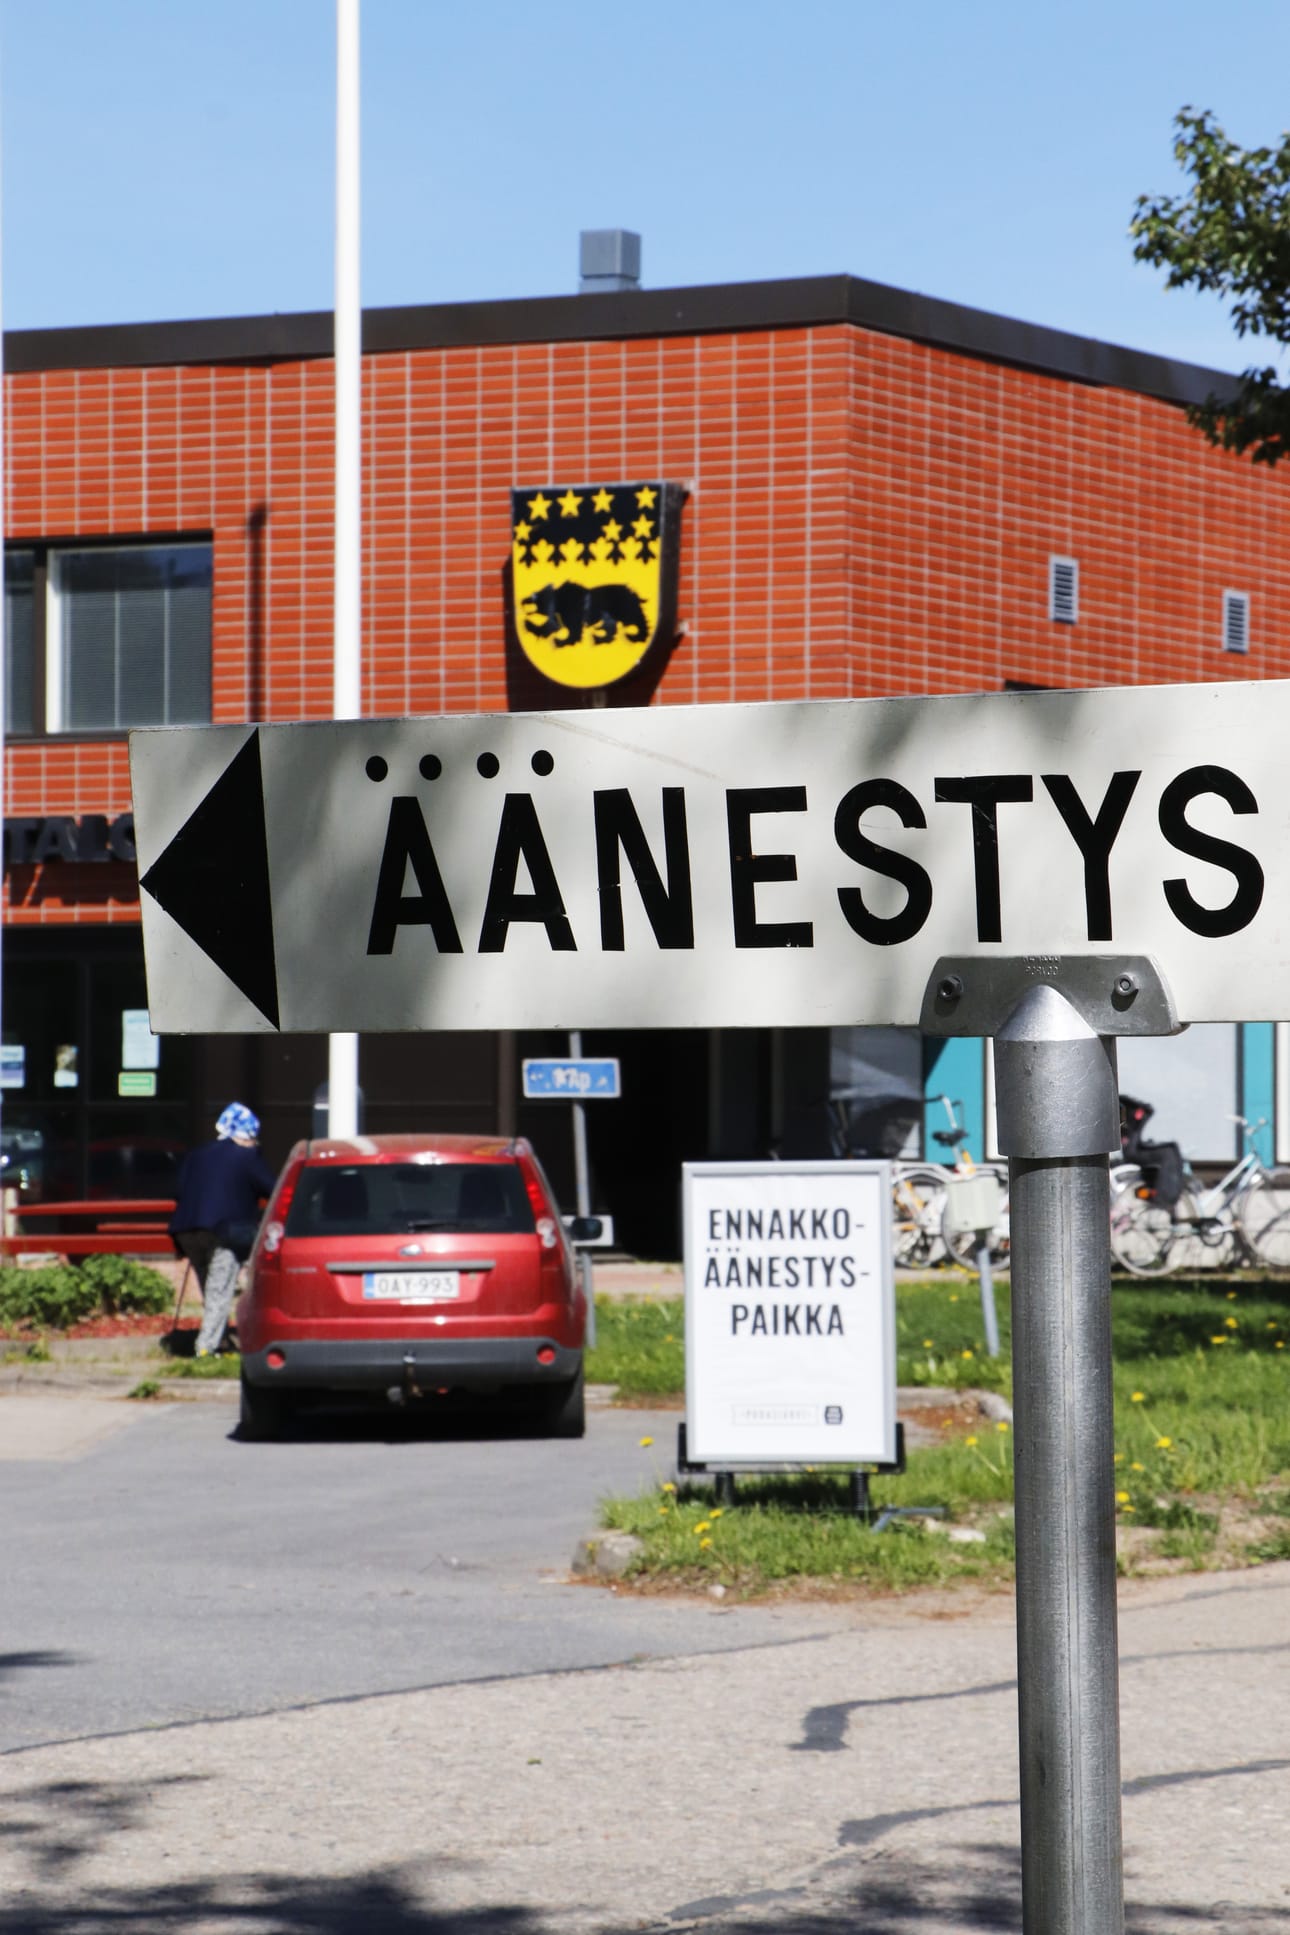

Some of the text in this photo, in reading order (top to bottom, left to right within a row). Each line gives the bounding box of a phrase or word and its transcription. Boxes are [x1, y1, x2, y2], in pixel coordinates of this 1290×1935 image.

[366, 749, 1265, 955] ÄÄNESTYS
[708, 1208, 865, 1241] ENNAKKO-
[704, 1247, 870, 1288] ÄÄNESTYS-
[730, 1303, 845, 1336] PAIKKA
